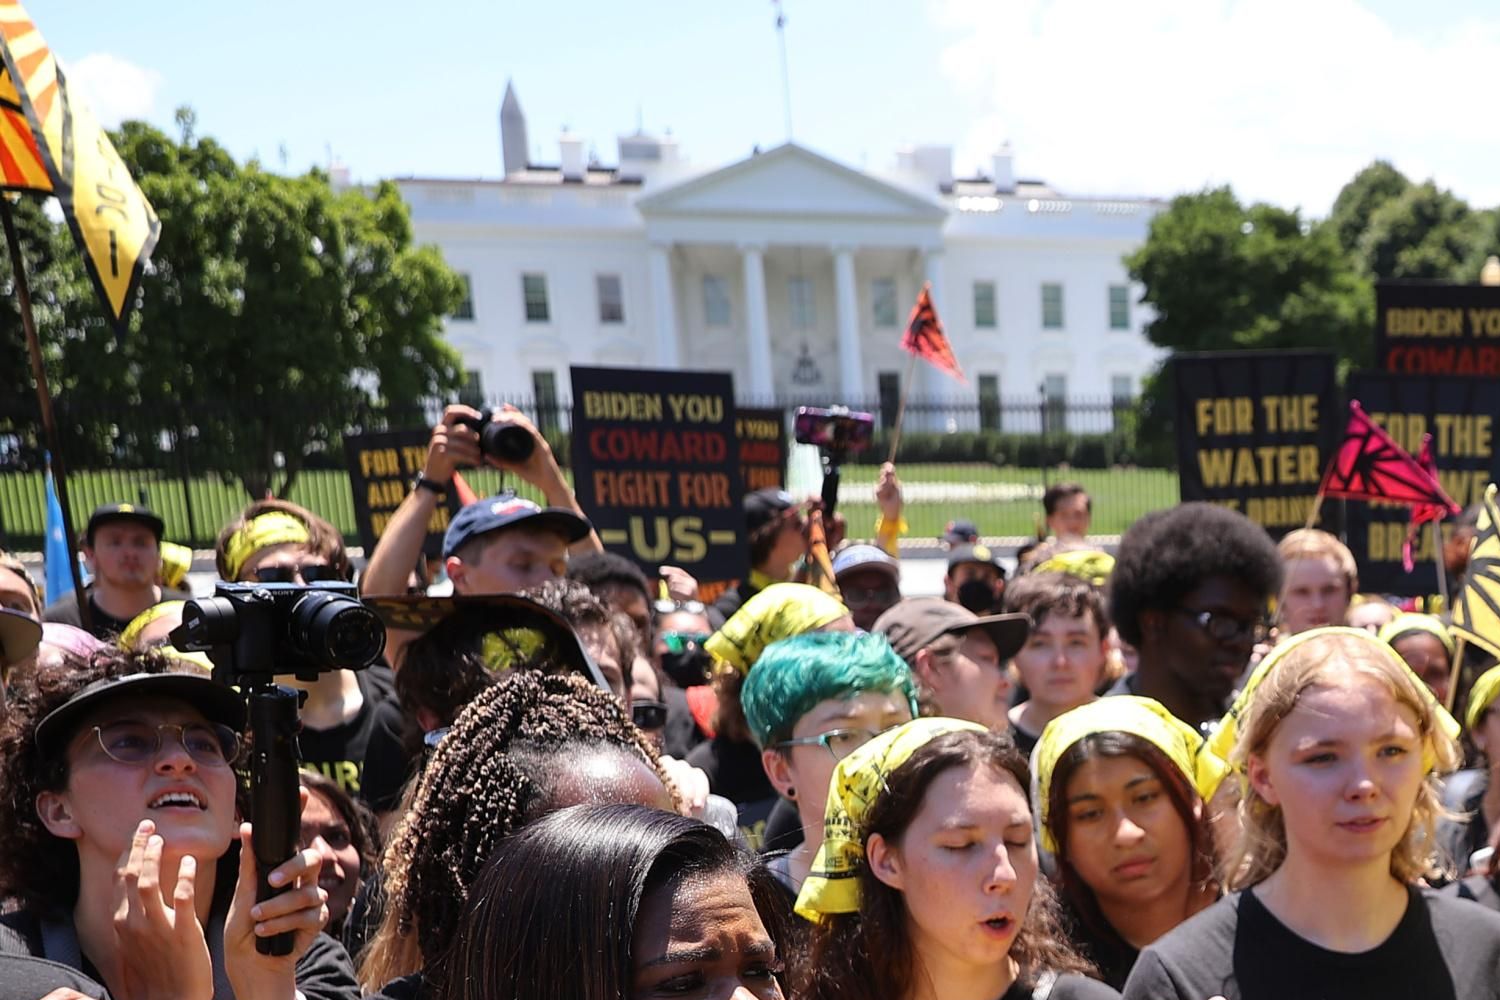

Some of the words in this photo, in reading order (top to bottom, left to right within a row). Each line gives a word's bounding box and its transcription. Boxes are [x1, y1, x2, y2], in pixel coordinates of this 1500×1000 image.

[1385, 307, 1464, 338] BIDEN
[583, 391, 662, 422] BIDEN
[666, 394, 725, 424] YOU
[1195, 396, 1255, 436] FOR
[1261, 394, 1320, 433] THE
[589, 428, 728, 464] COWARD
[1434, 414, 1492, 457] THE
[1197, 444, 1321, 488] WATER
[593, 468, 672, 507] FIGHT
[677, 473, 732, 508] FOR
